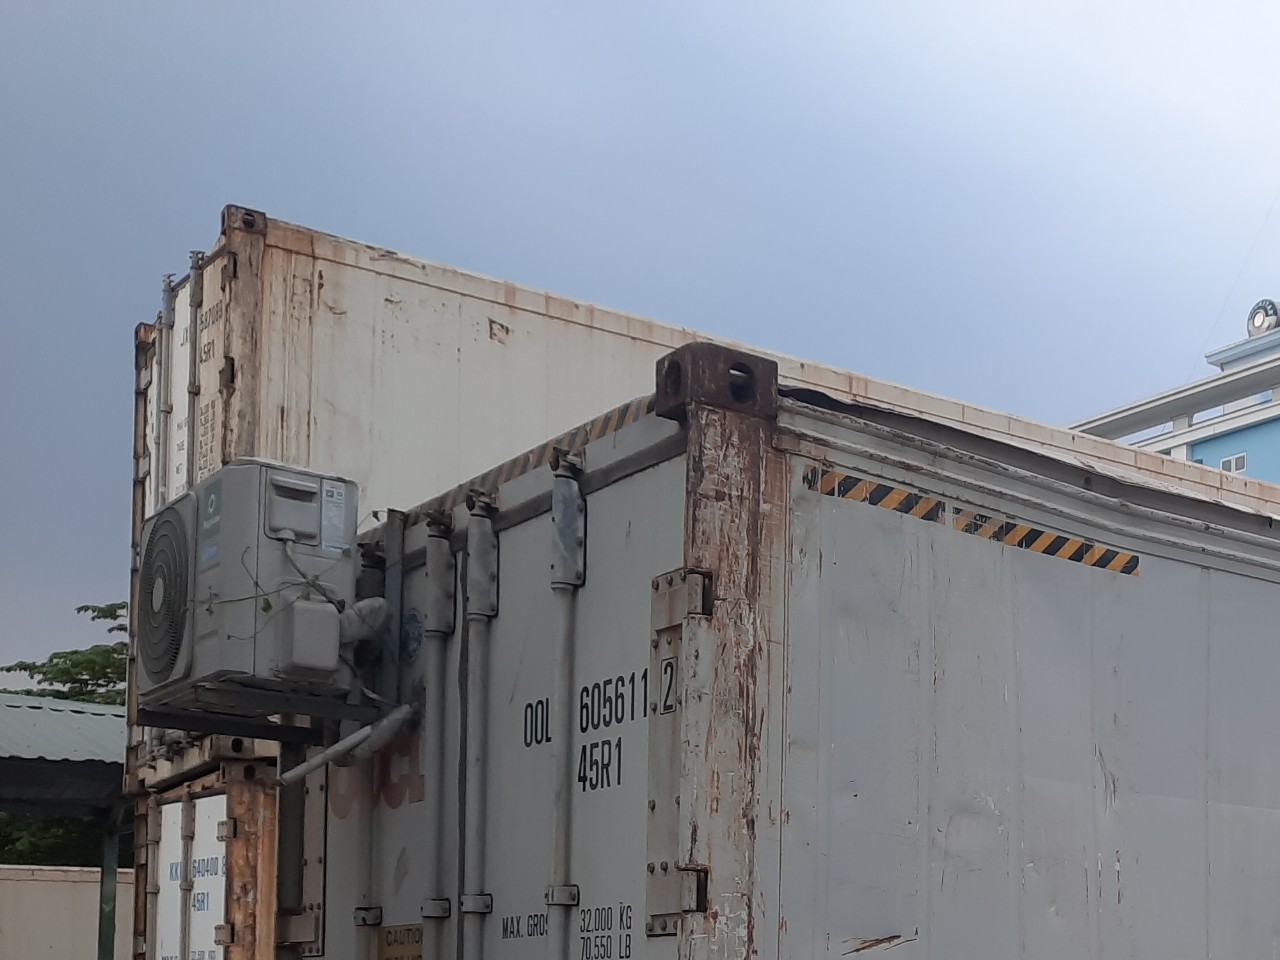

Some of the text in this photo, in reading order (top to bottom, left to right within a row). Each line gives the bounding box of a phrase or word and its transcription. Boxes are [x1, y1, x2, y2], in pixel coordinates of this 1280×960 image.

[579, 667, 649, 733] 605611
[662, 661, 674, 712] 2
[577, 737, 622, 792] 45R1
[192, 892, 209, 912] 45R1
[502, 916, 524, 939] MAX.
[579, 905, 632, 933] 32,000 KG
[580, 934, 631, 960] 70,550 LB
